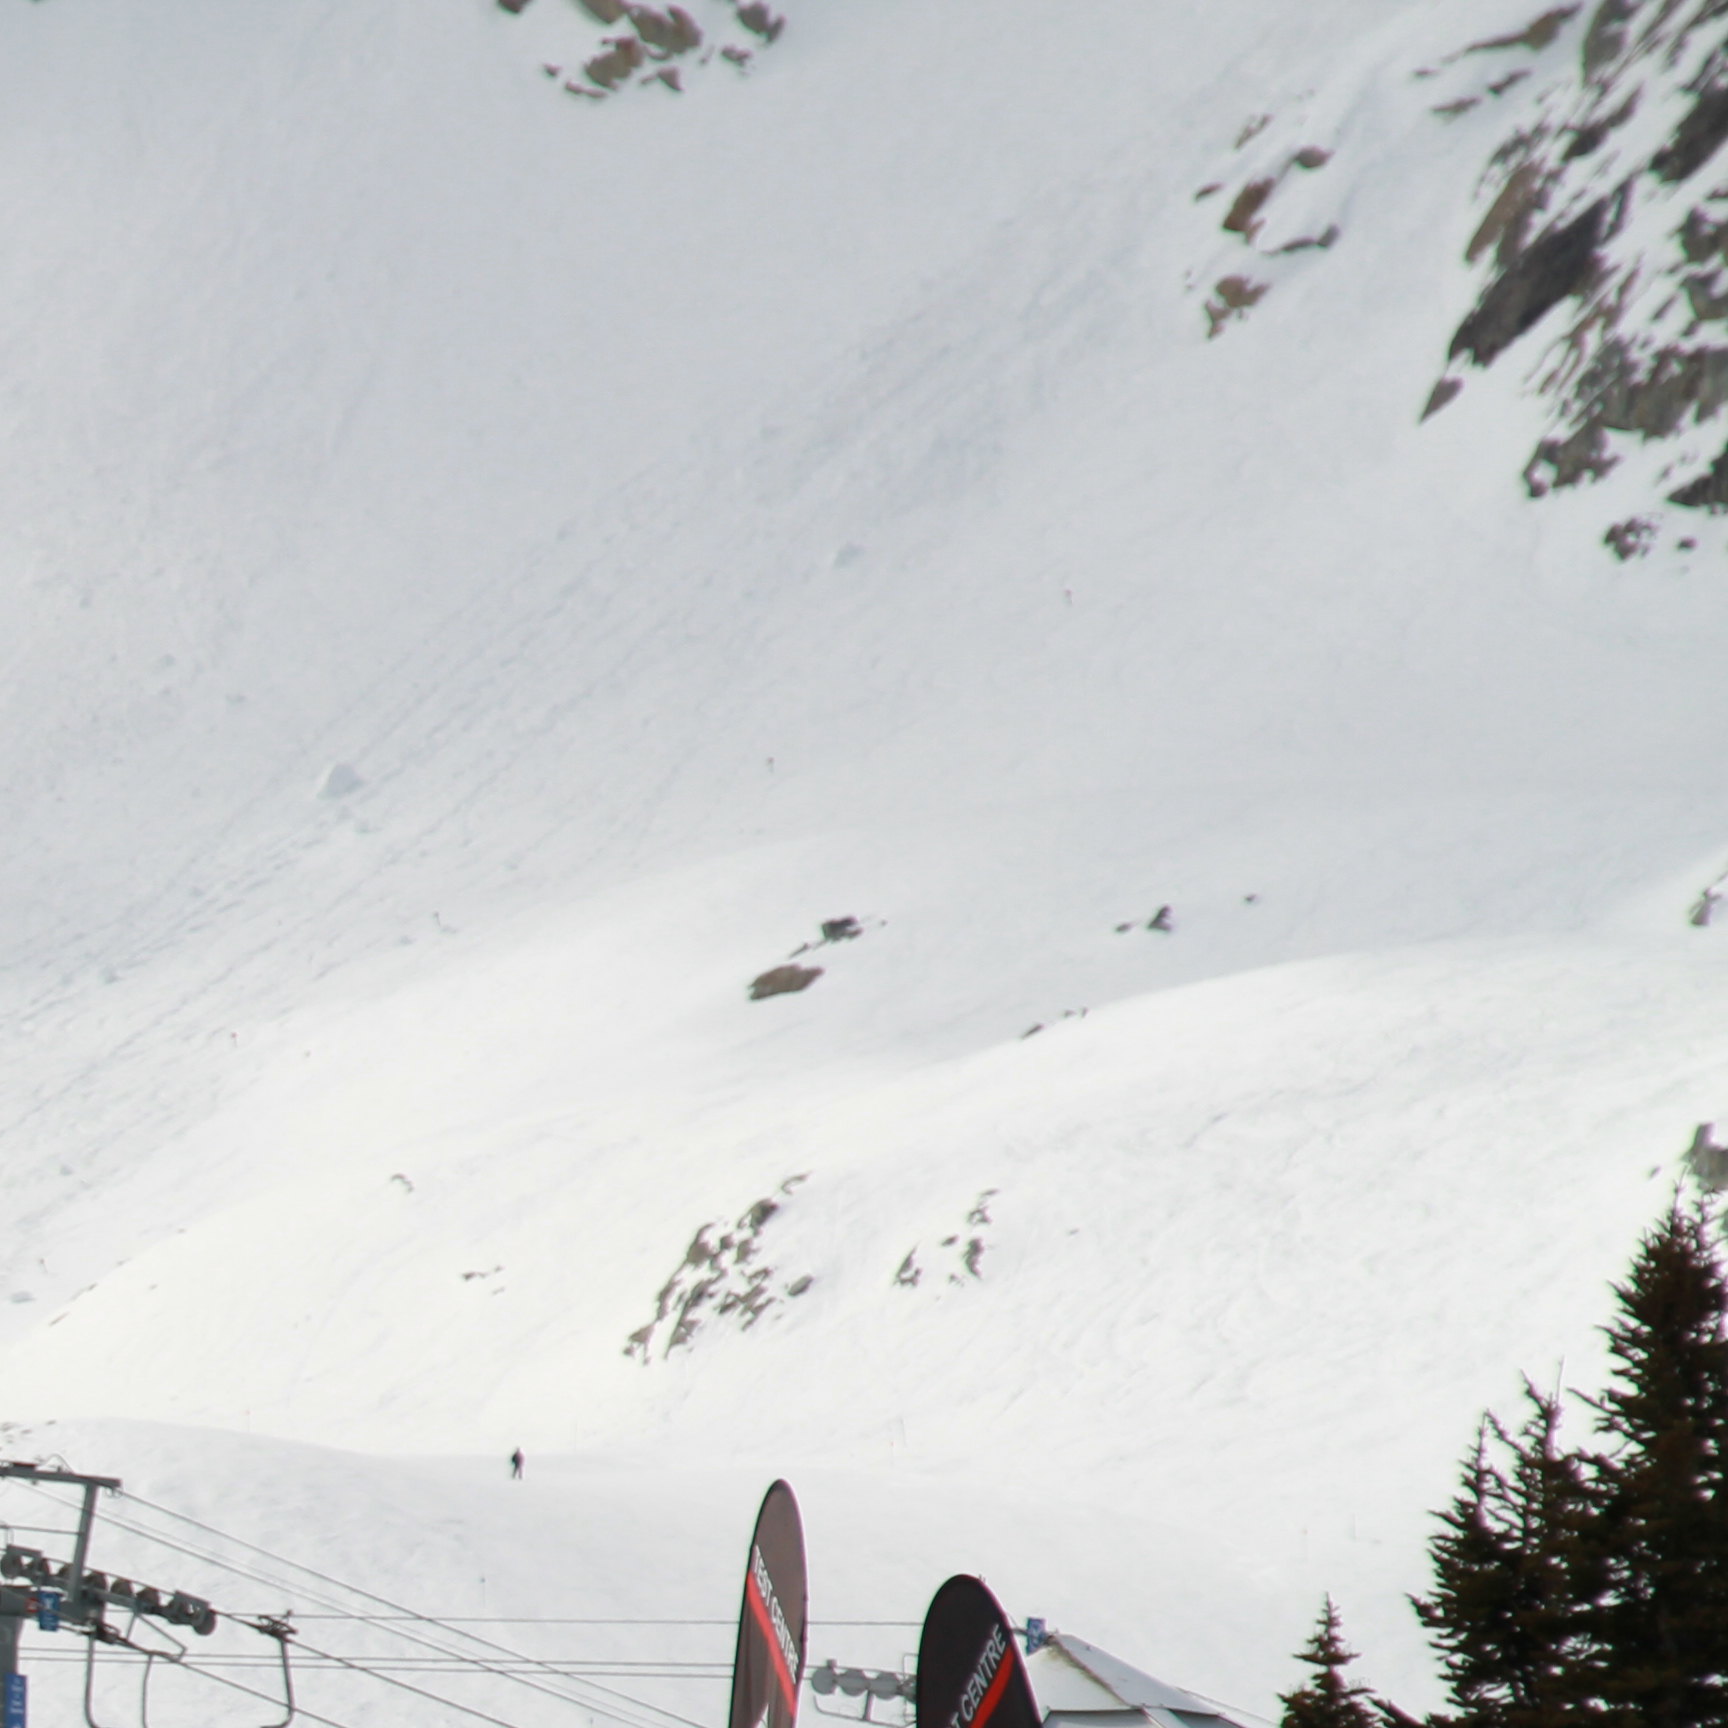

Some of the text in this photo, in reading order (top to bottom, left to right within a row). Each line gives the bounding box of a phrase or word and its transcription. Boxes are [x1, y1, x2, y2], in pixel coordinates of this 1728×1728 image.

[752, 1545, 799, 1683] TEST CENTRE
[960, 1623, 1007, 1723] CENTRE
